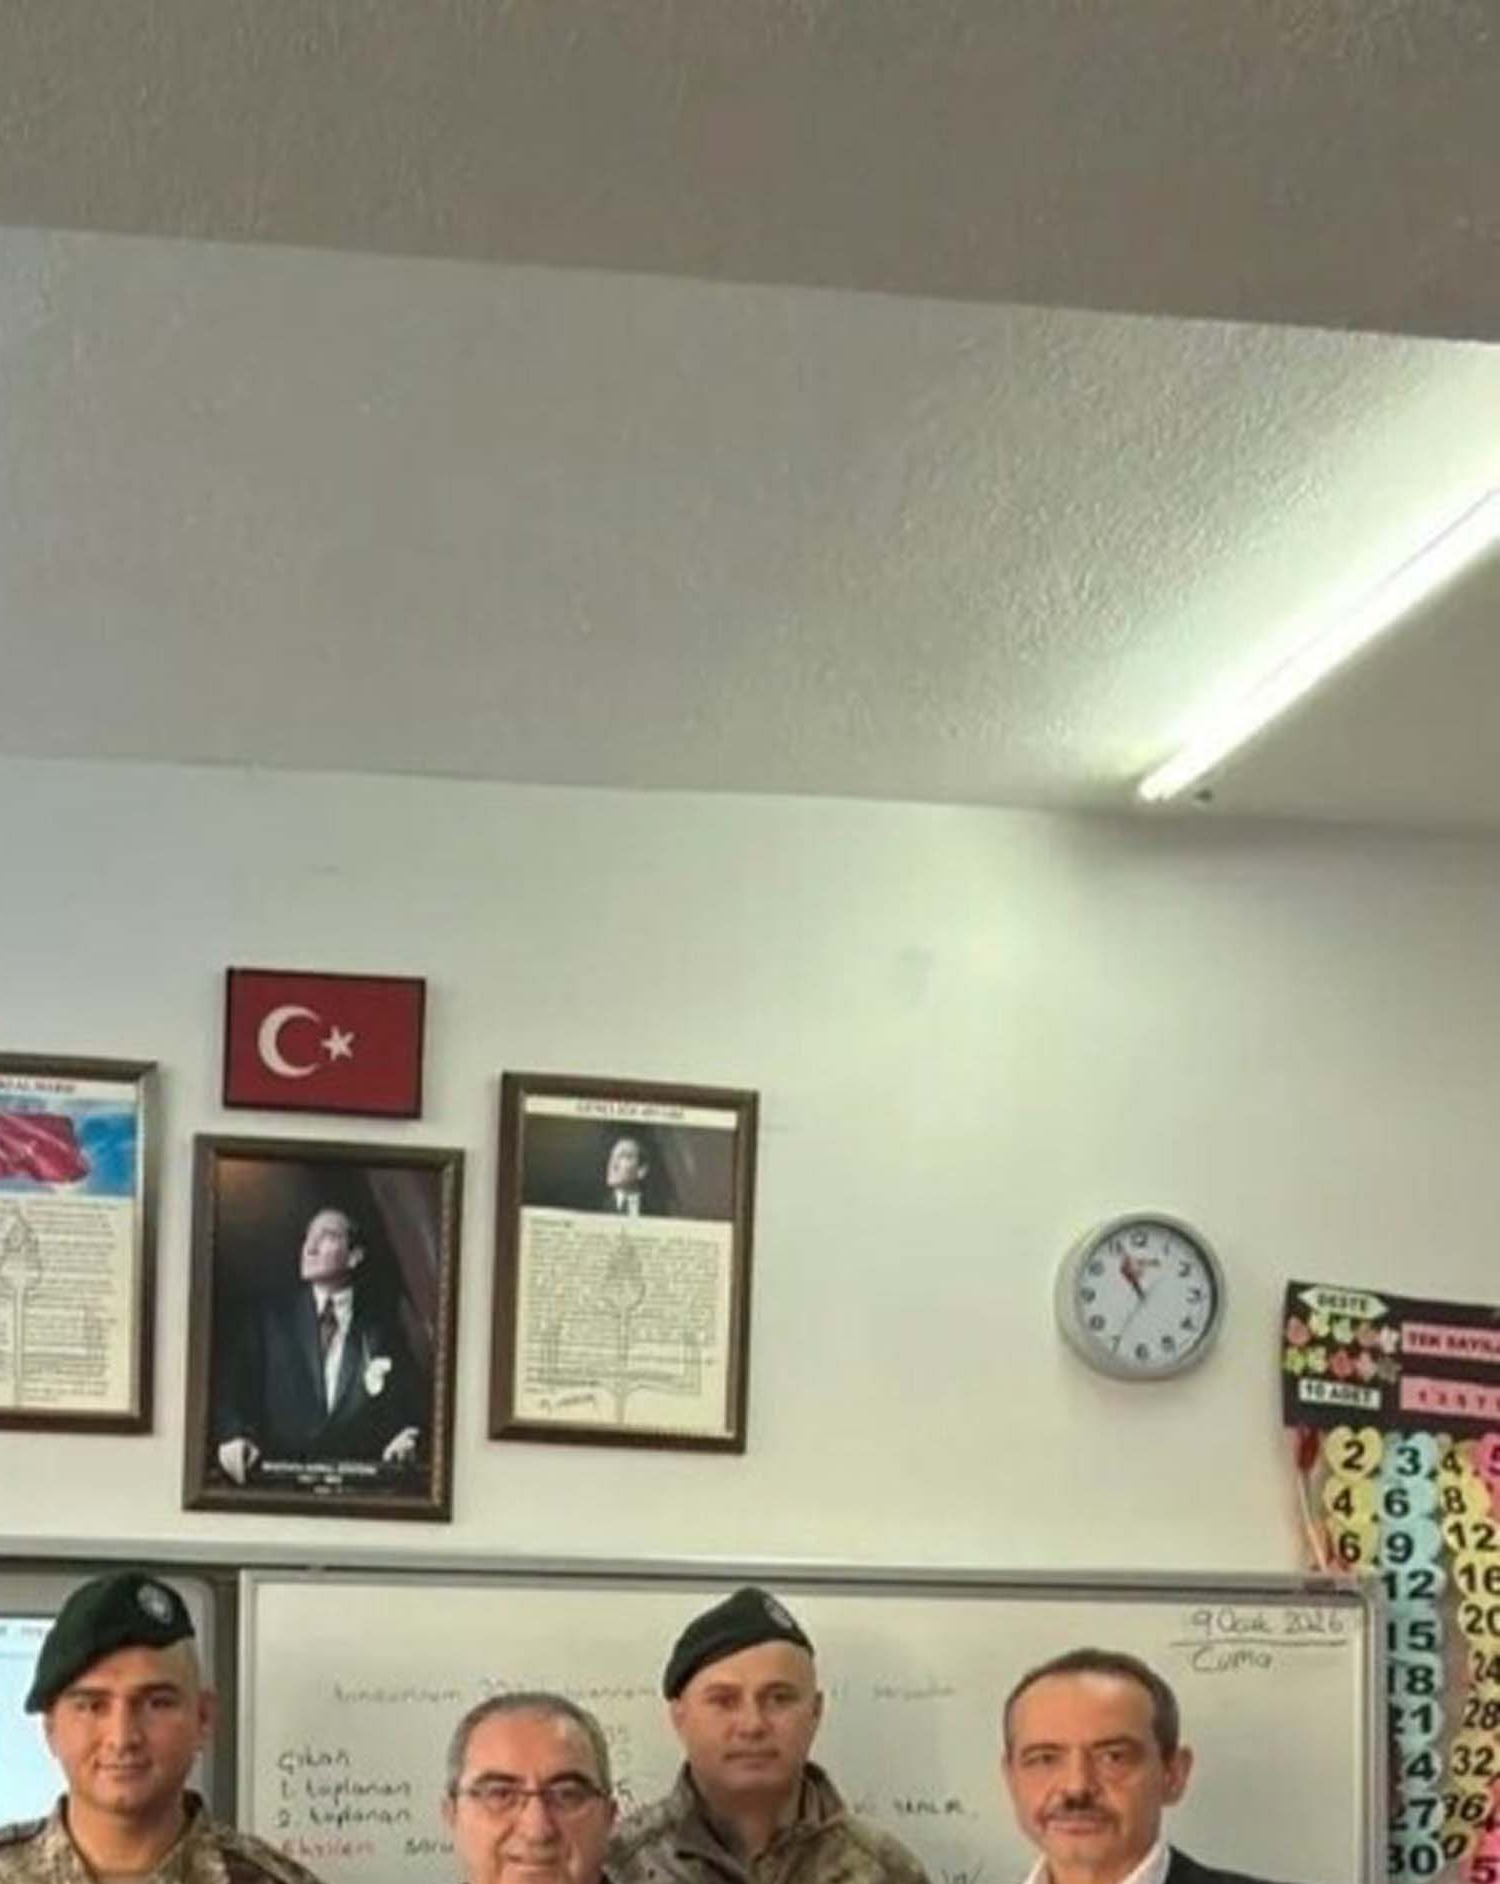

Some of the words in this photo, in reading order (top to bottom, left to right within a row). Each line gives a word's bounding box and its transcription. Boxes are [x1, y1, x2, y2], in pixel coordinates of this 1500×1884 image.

[1342, 1439, 1365, 1471] 2
[1396, 1447, 1422, 1477] 3
[1442, 1451, 1462, 1476] 4
[1333, 1488, 1354, 1518] 4
[1384, 1487, 1410, 1519] 6
[1443, 1486, 1467, 1515] 8
[1338, 1531, 1361, 1563] 6
[1386, 1531, 1414, 1564] 9
[1447, 1522, 1498, 1551] 12
[1382, 1569, 1435, 1600] 12
[1459, 1562, 1500, 1596] 16
[1386, 1621, 1435, 1652] 15
[1386, 1664, 1435, 1696] 18
[1464, 1698, 1500, 1730] 28
[1452, 1745, 1495, 1777] 32
